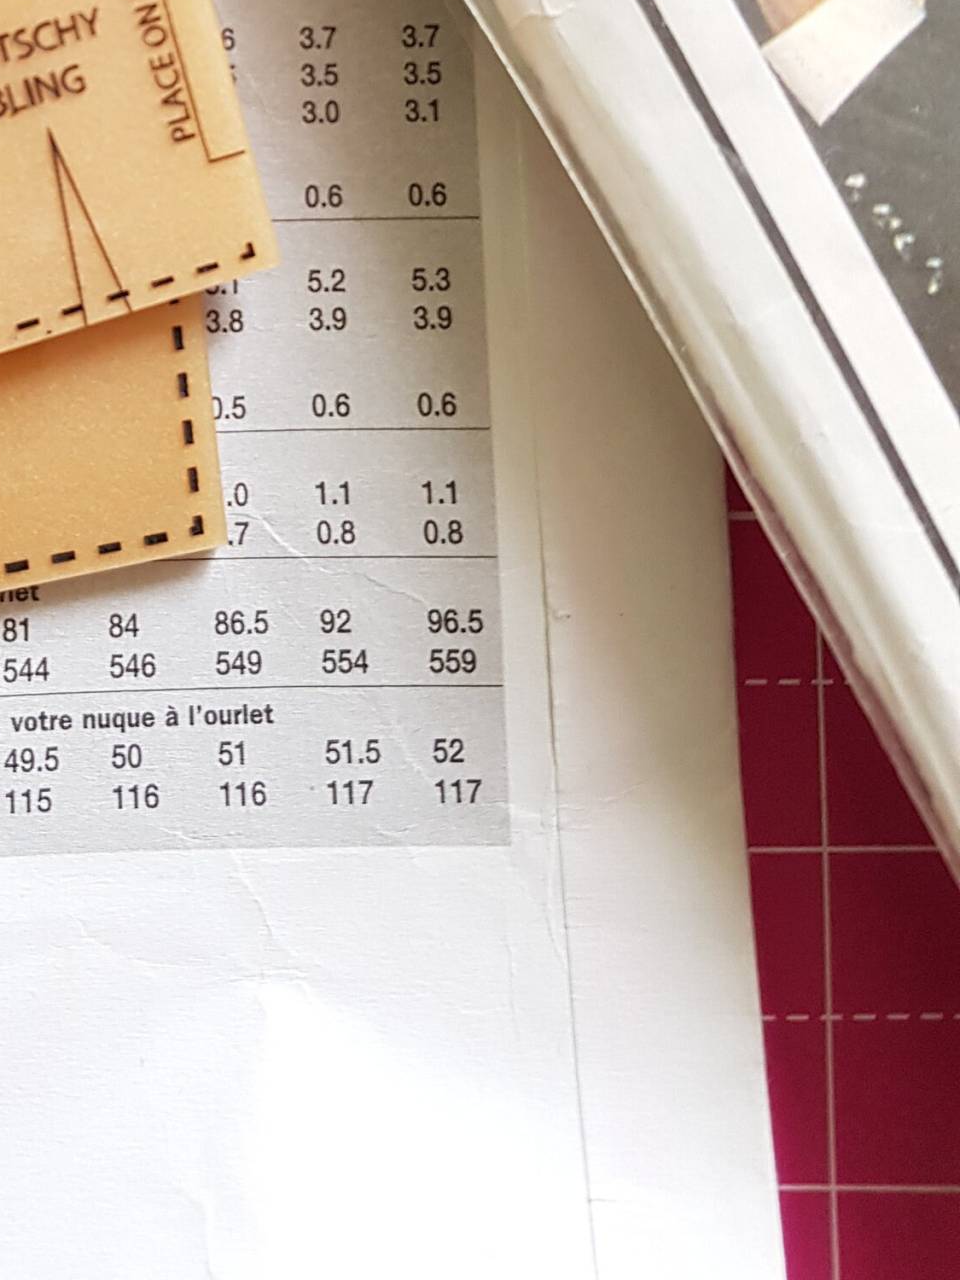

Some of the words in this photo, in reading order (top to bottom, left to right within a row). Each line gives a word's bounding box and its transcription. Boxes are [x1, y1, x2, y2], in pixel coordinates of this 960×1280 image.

[138, 2, 174, 50] ON
[299, 25, 338, 50] 3.7
[401, 23, 441, 48] 3.7
[151, 52, 196, 144] PLACE
[3, 656, 50, 684] 544
[109, 652, 157, 679] 546
[215, 649, 263, 676] 549
[321, 648, 369, 674] 554
[429, 648, 477, 674] 559
[10, 711, 73, 733] votre
[82, 711, 156, 734] nuque
[165, 705, 180, 727] à
[189, 703, 275, 726] l'ourlet
